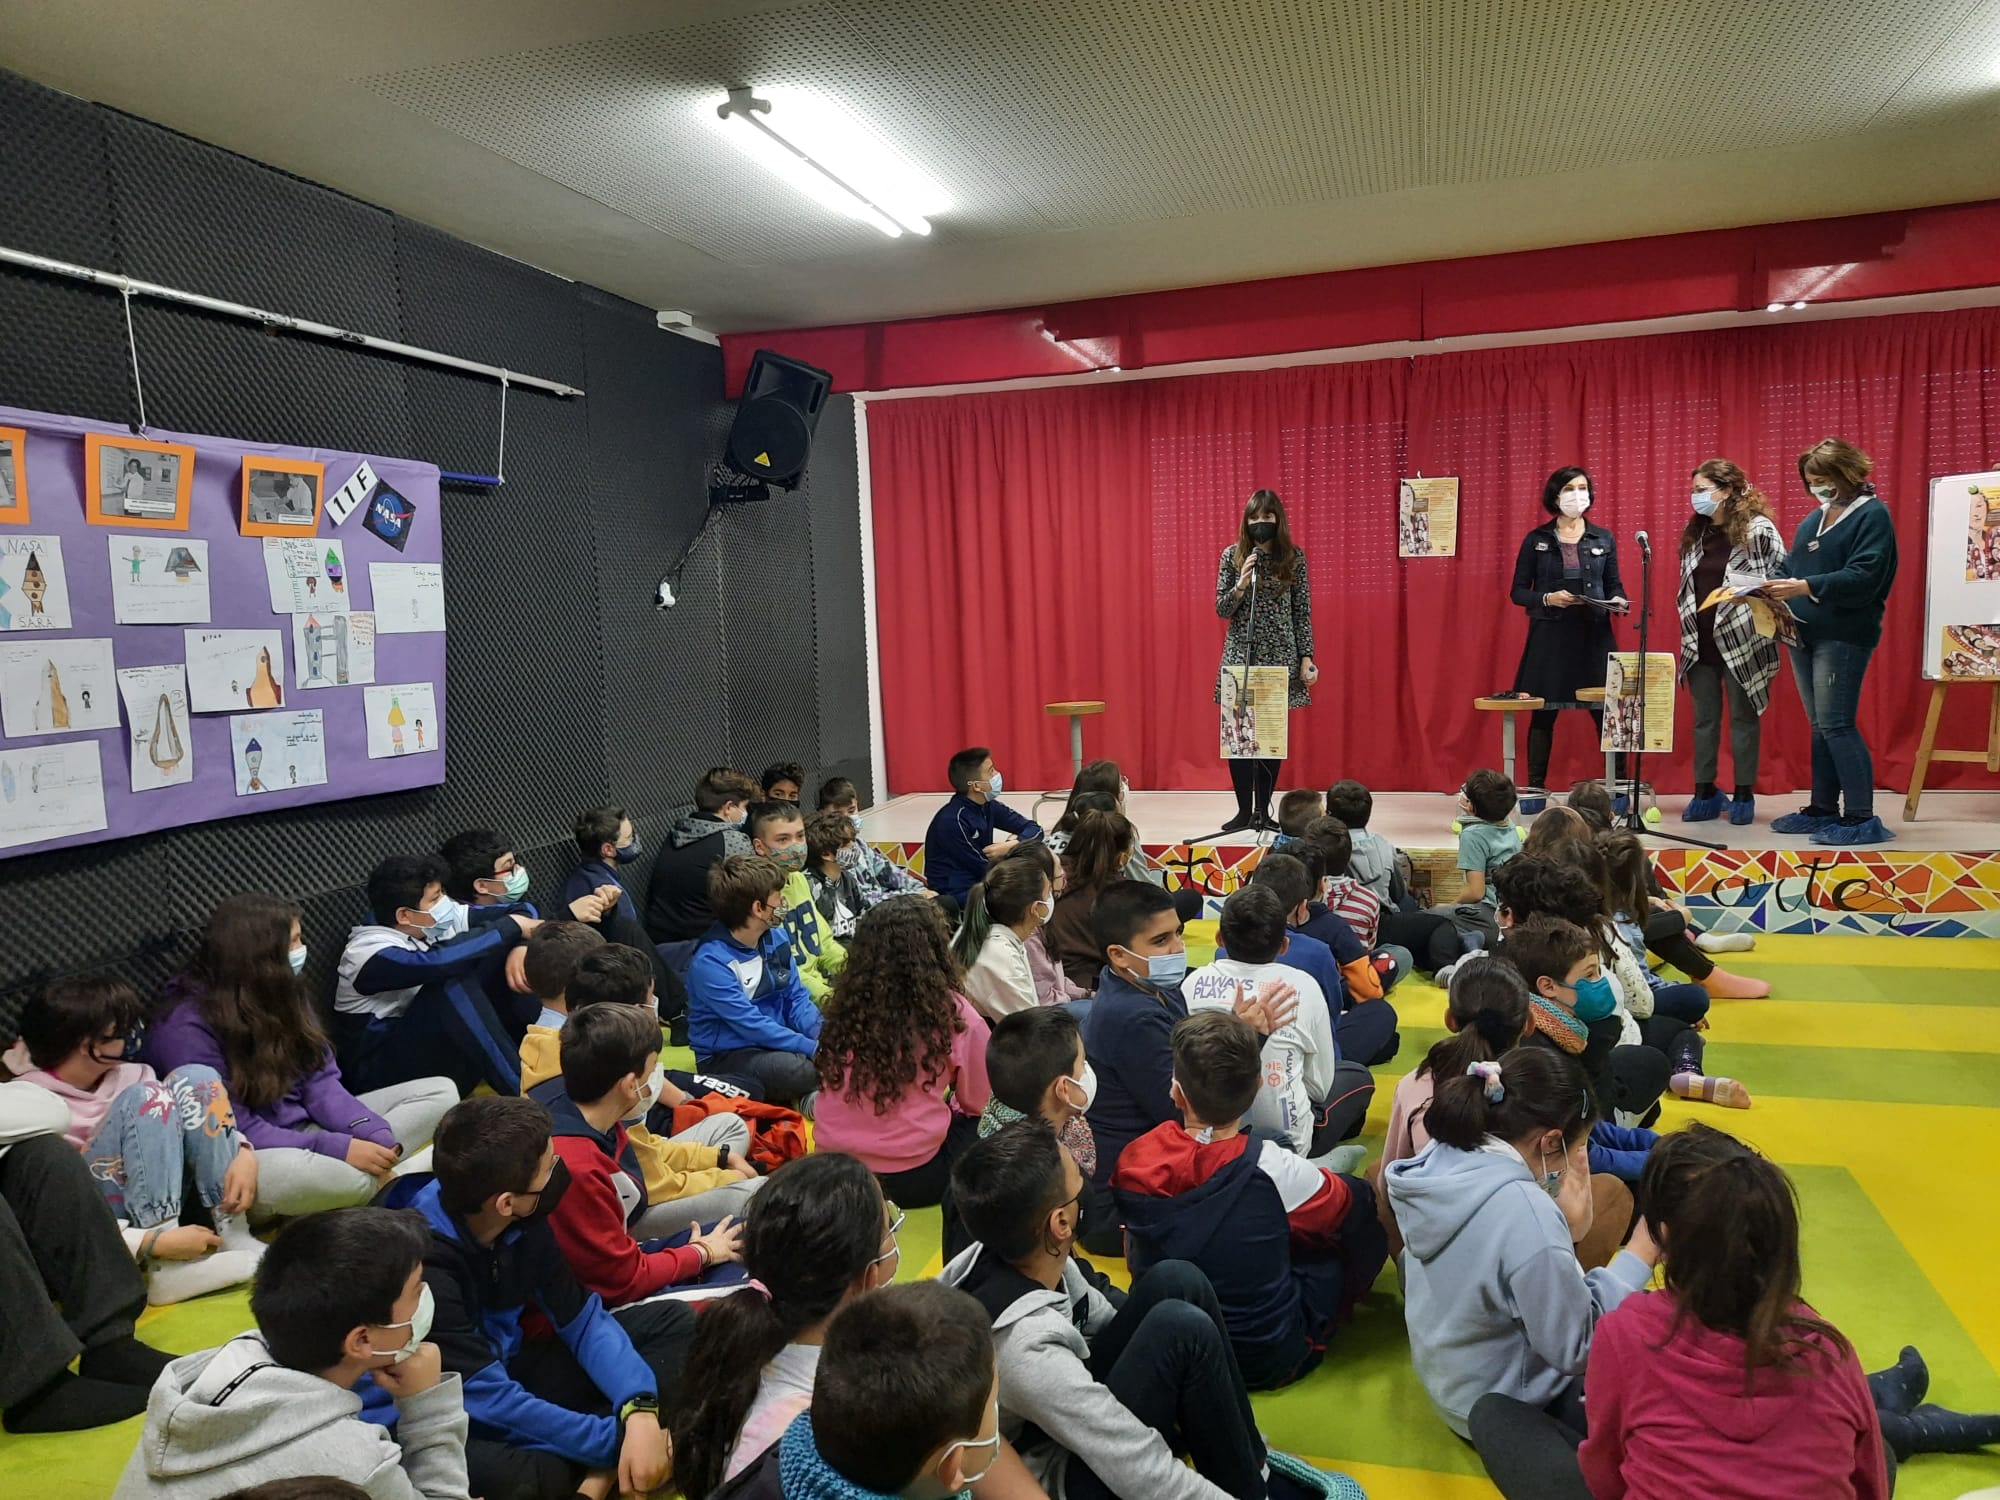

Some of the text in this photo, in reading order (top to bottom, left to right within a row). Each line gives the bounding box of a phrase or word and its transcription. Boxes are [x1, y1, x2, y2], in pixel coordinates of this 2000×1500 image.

[375, 503, 401, 529] NASA
[7, 539, 45, 554] NASA
[18, 616, 55, 628] SARA
[1194, 976, 1254, 991] ALWAYS
[693, 1074, 750, 1098] LEGEA
